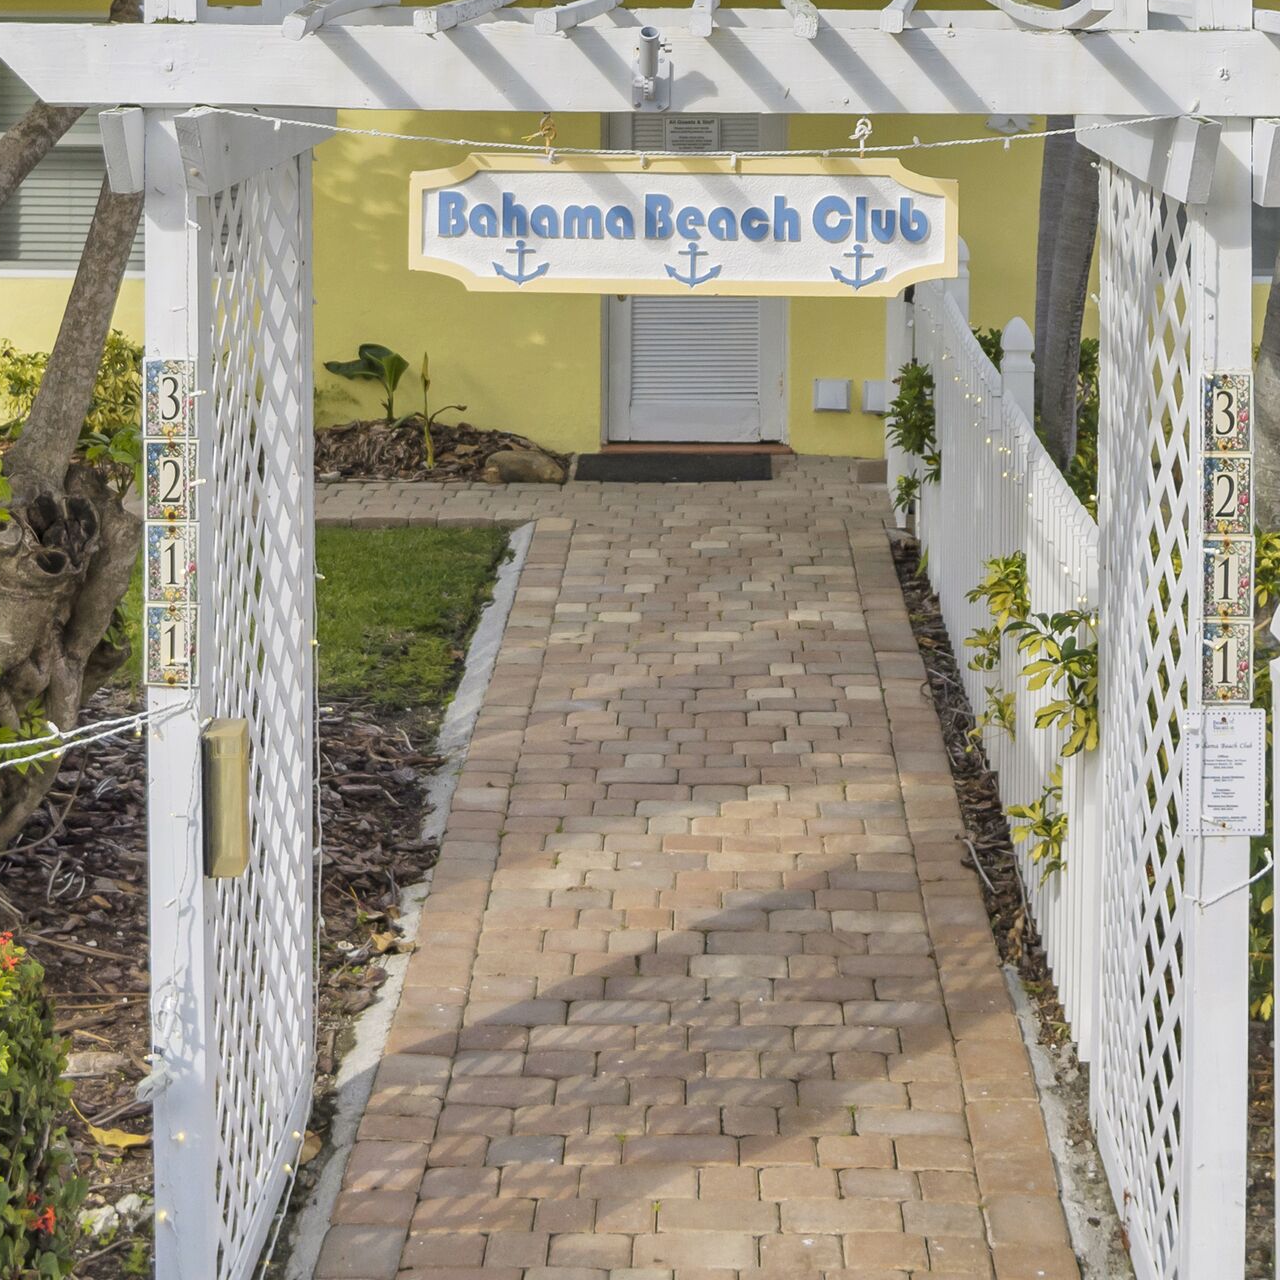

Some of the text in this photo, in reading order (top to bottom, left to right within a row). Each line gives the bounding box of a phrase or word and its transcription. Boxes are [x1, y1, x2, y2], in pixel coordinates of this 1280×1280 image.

[437, 191, 931, 243] Bahama Beach Club
